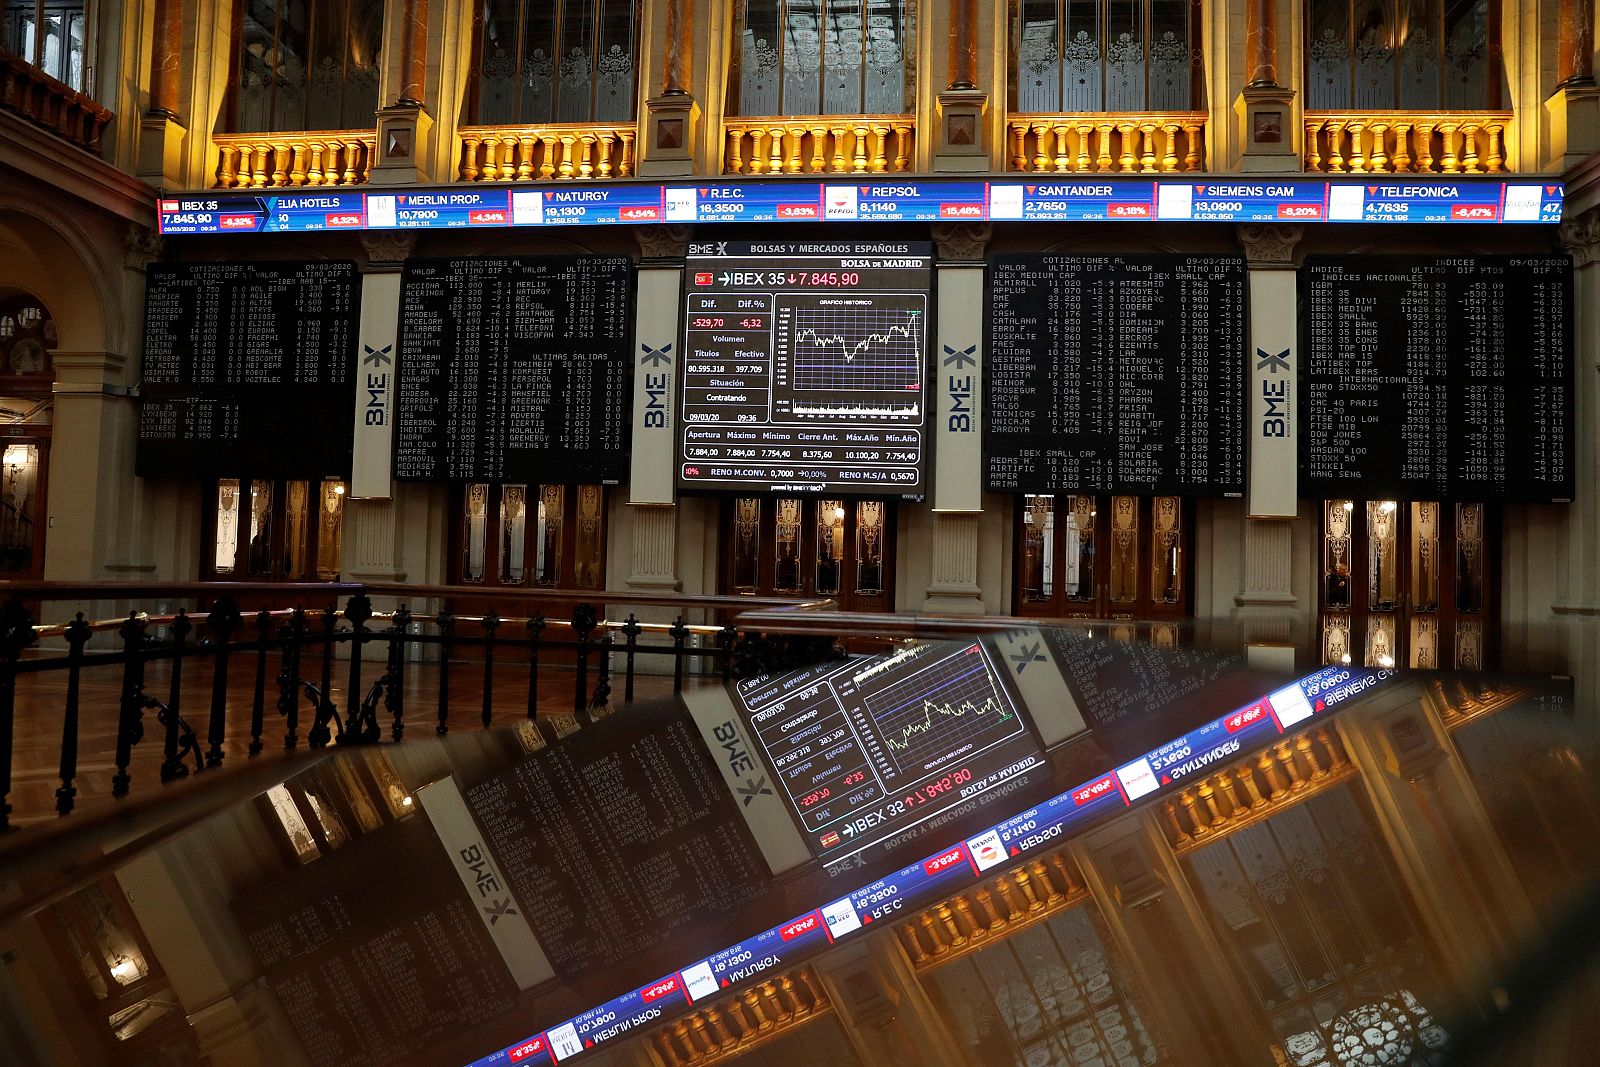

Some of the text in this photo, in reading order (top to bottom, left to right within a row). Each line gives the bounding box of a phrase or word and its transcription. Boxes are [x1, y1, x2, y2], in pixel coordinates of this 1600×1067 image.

[711, 188, 744, 198] R.E.C.
[872, 187, 920, 197] REPSOL
[1038, 186, 1112, 196] SANTANDER
[1207, 186, 1294, 197] SIEMENS GAM
[1380, 187, 1458, 197] TELEFONICA
[408, 195, 482, 206] MERLIN PROP.
[556, 191, 608, 202] NATURGY
[182, 200, 218, 211] IBEX 35
[300, 198, 340, 208] HOTELS
[860, 203, 896, 212] 8,1140
[1026, 202, 1066, 212] 2,7650
[1194, 202, 1242, 211] 13,0900
[1366, 203, 1408, 213] 4,7635
[398, 210, 438, 220] 10,7900
[545, 207, 586, 216] 19,1300
[624, 209, 655, 218] -4,54%
[942, 207, 980, 215] -15,48%
[1112, 206, 1146, 215] -9,18%
[1282, 208, 1317, 216] -8,20%
[1455, 208, 1492, 217] -6,47%
[162, 214, 212, 224] 7.845,90
[223, 217, 252, 226] -6,32%
[329, 216, 359, 226] -6,32%
[472, 213, 504, 222] -4,34%
[689, 245, 713, 255] BME
[750, 244, 908, 253] BOLSAS Y MERCADOS ESPAÑOLES
[841, 260, 870, 268] BOLSA
[883, 260, 922, 268] MADRID
[731, 272, 859, 287] IBEX 35 7.845,90
[701, 300, 716, 308] Dif.
[692, 319, 762, 328] -529,70 -6,32
[690, 413, 719, 421] 09/03/20
[762, 432, 790, 440] Mínimo
[798, 433, 819, 441] Cierre
[689, 448, 916, 461] 7.884,00 7.884,00 7.754,40 8.375,60 10.100,20 7.754,40
[711, 468, 732, 476] RENO
[734, 469, 767, 477] M.CONV.
[770, 470, 794, 478] 0,7000
[804, 470, 827, 478] 0,00%
[891, 473, 915, 481] 0,5670
